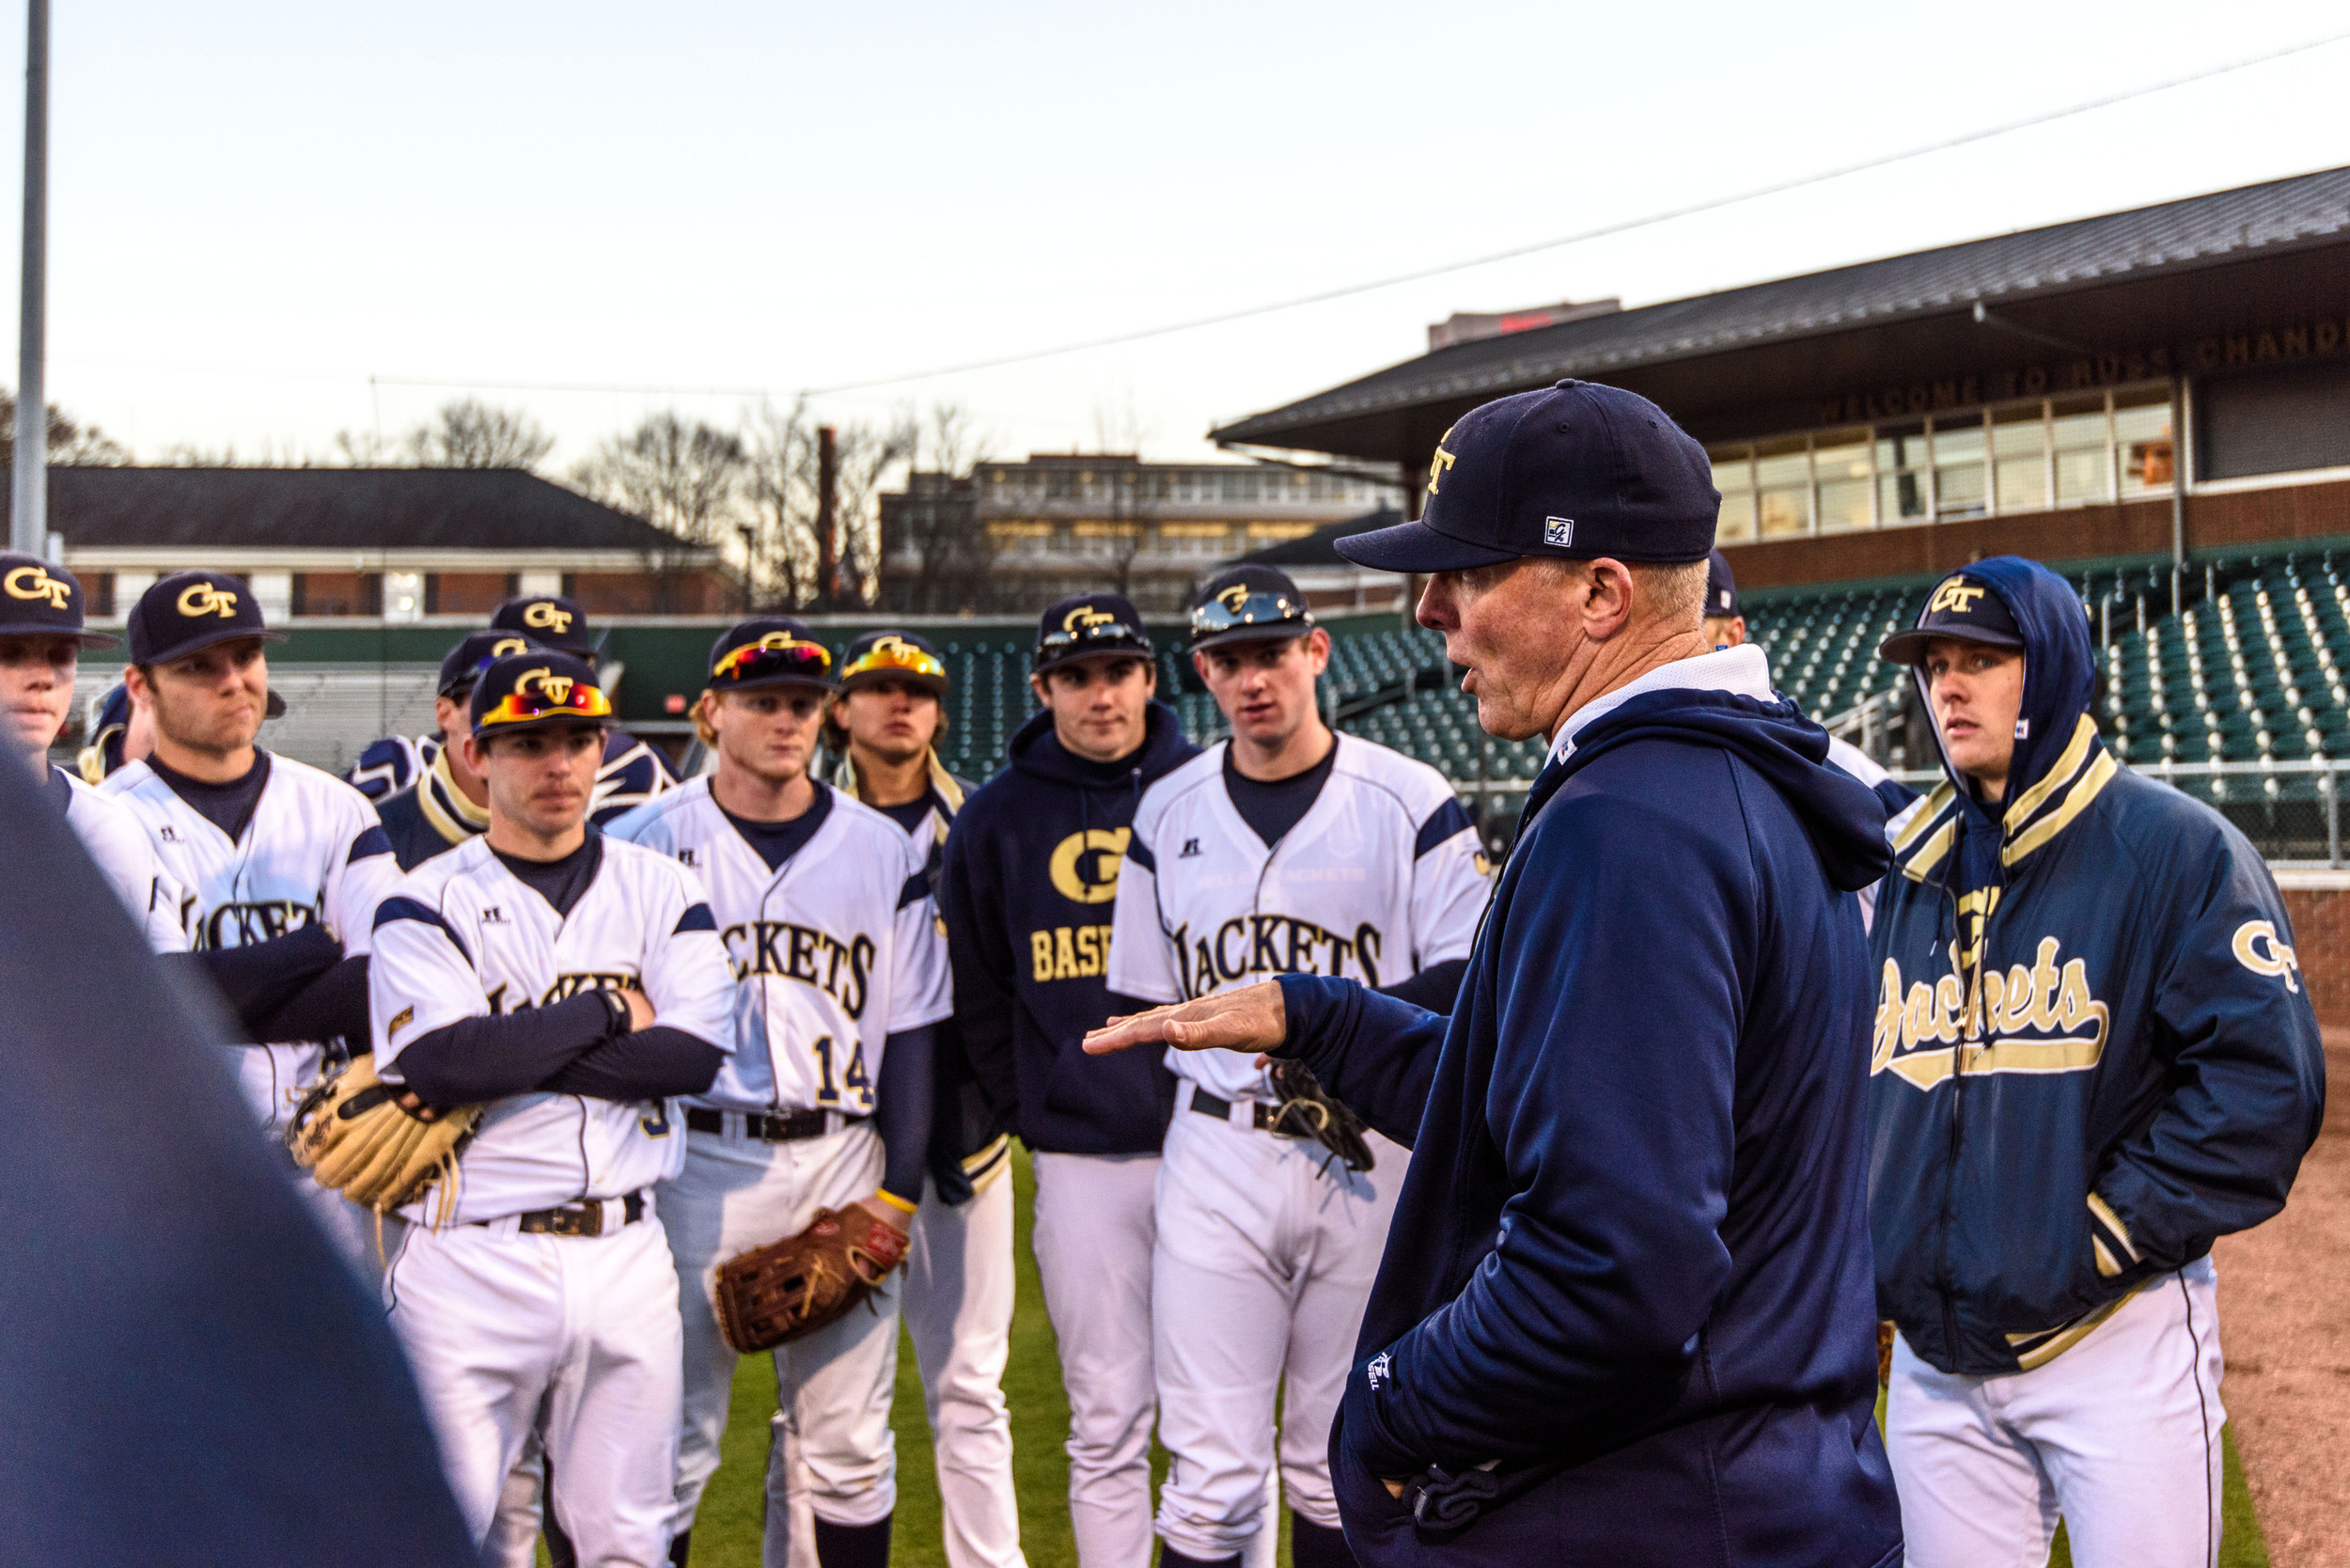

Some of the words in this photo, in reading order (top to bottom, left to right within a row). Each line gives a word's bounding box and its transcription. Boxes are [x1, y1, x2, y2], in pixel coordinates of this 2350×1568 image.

[1820, 375, 1978, 422] WELCOME
[2003, 365, 2048, 396] TO
[2194, 318, 2350, 369] CHAND
[3, 566, 71, 610] GT
[177, 581, 238, 619] GT
[523, 602, 573, 634] GT
[1931, 574, 1984, 613] GT
[1049, 826, 1132, 903] G
[1173, 913, 1382, 1000] JACKETS
[2232, 919, 2299, 994] GT
[1870, 935, 2096, 1076] Jackets
[811, 1035, 874, 1108] 14
